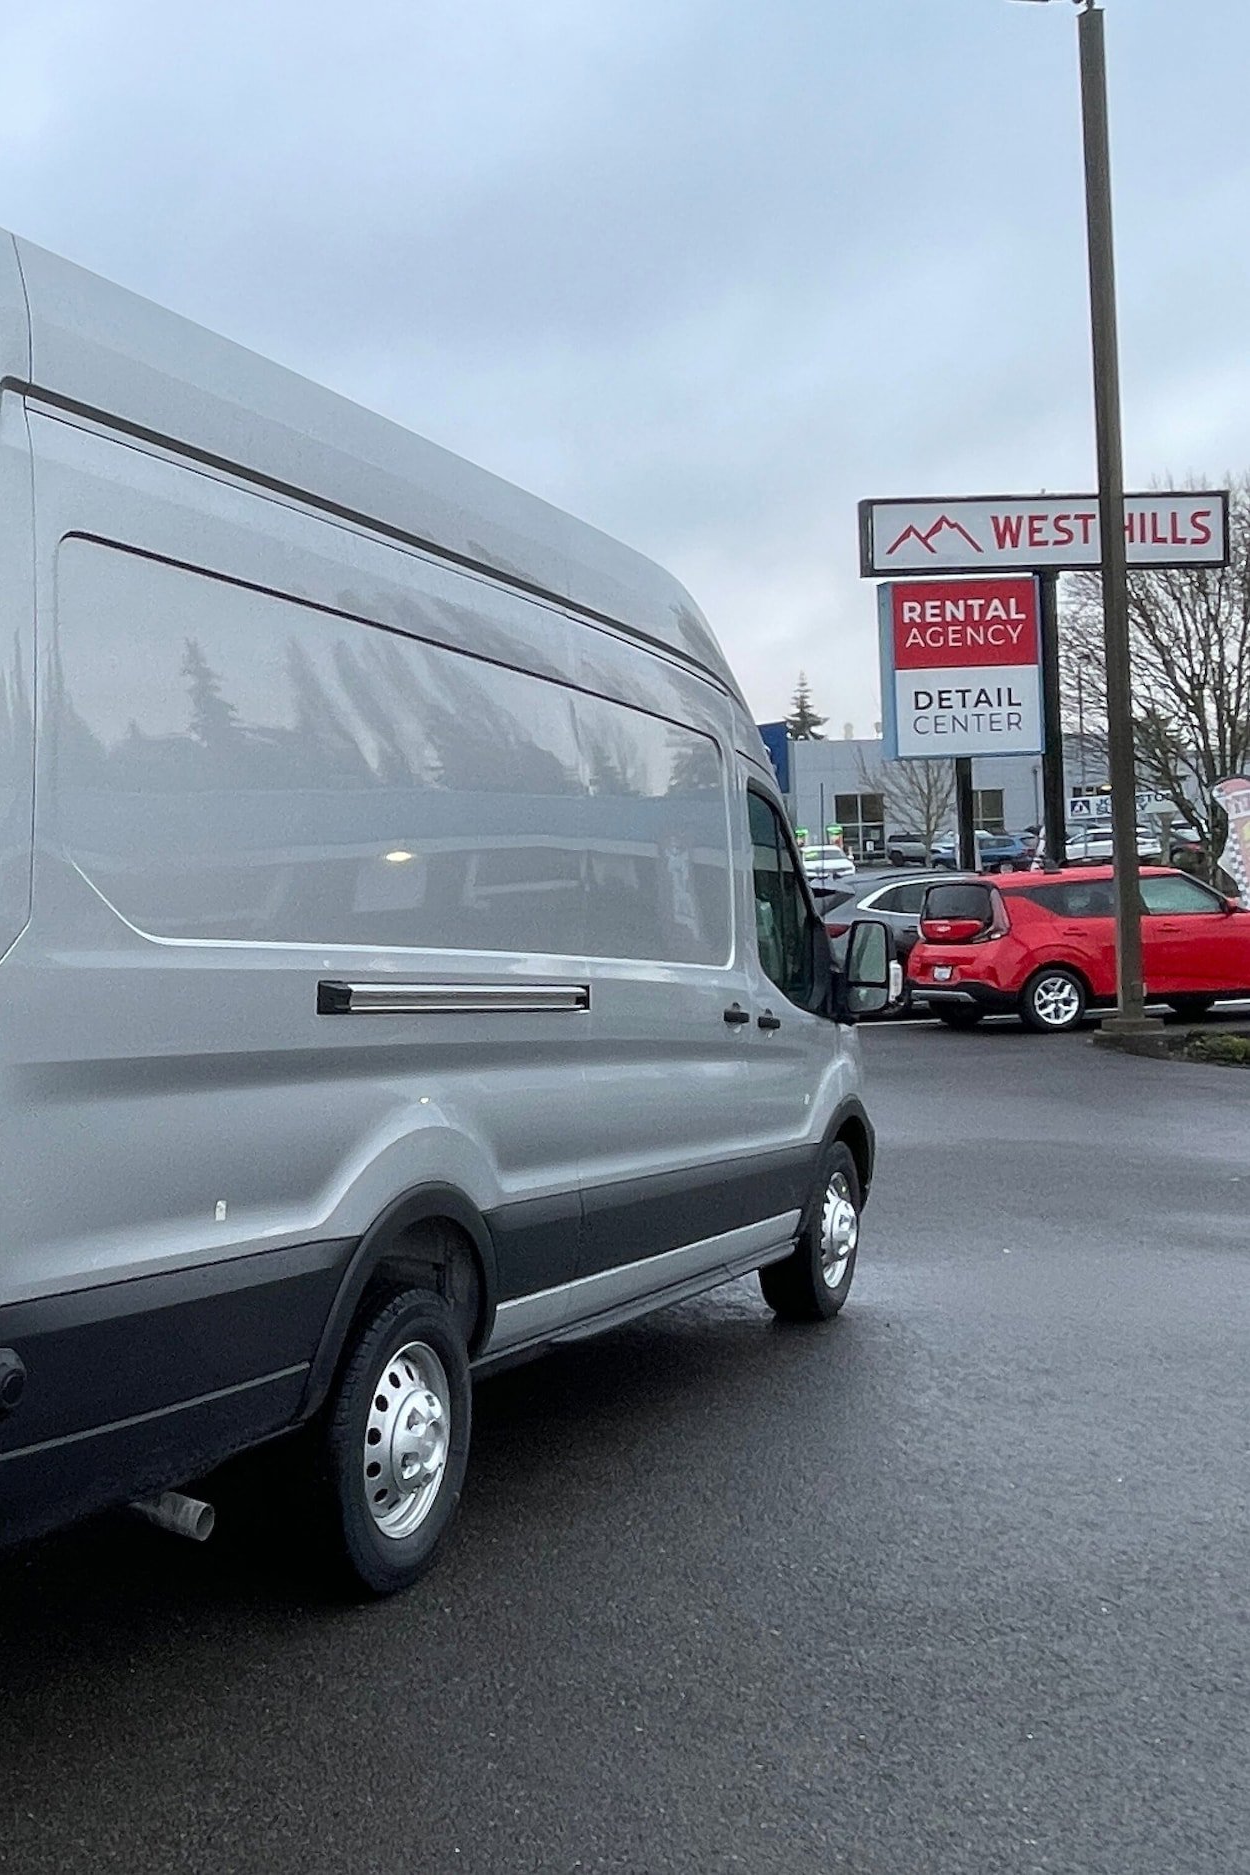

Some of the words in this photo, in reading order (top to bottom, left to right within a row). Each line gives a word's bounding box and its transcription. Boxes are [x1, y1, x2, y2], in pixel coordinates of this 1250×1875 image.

[990, 514, 1096, 549] WEST
[902, 597, 1027, 623] RENTAL
[905, 624, 1023, 648] AGENCY
[913, 687, 1022, 711] DETAIL
[913, 712, 1022, 735] CENTER
